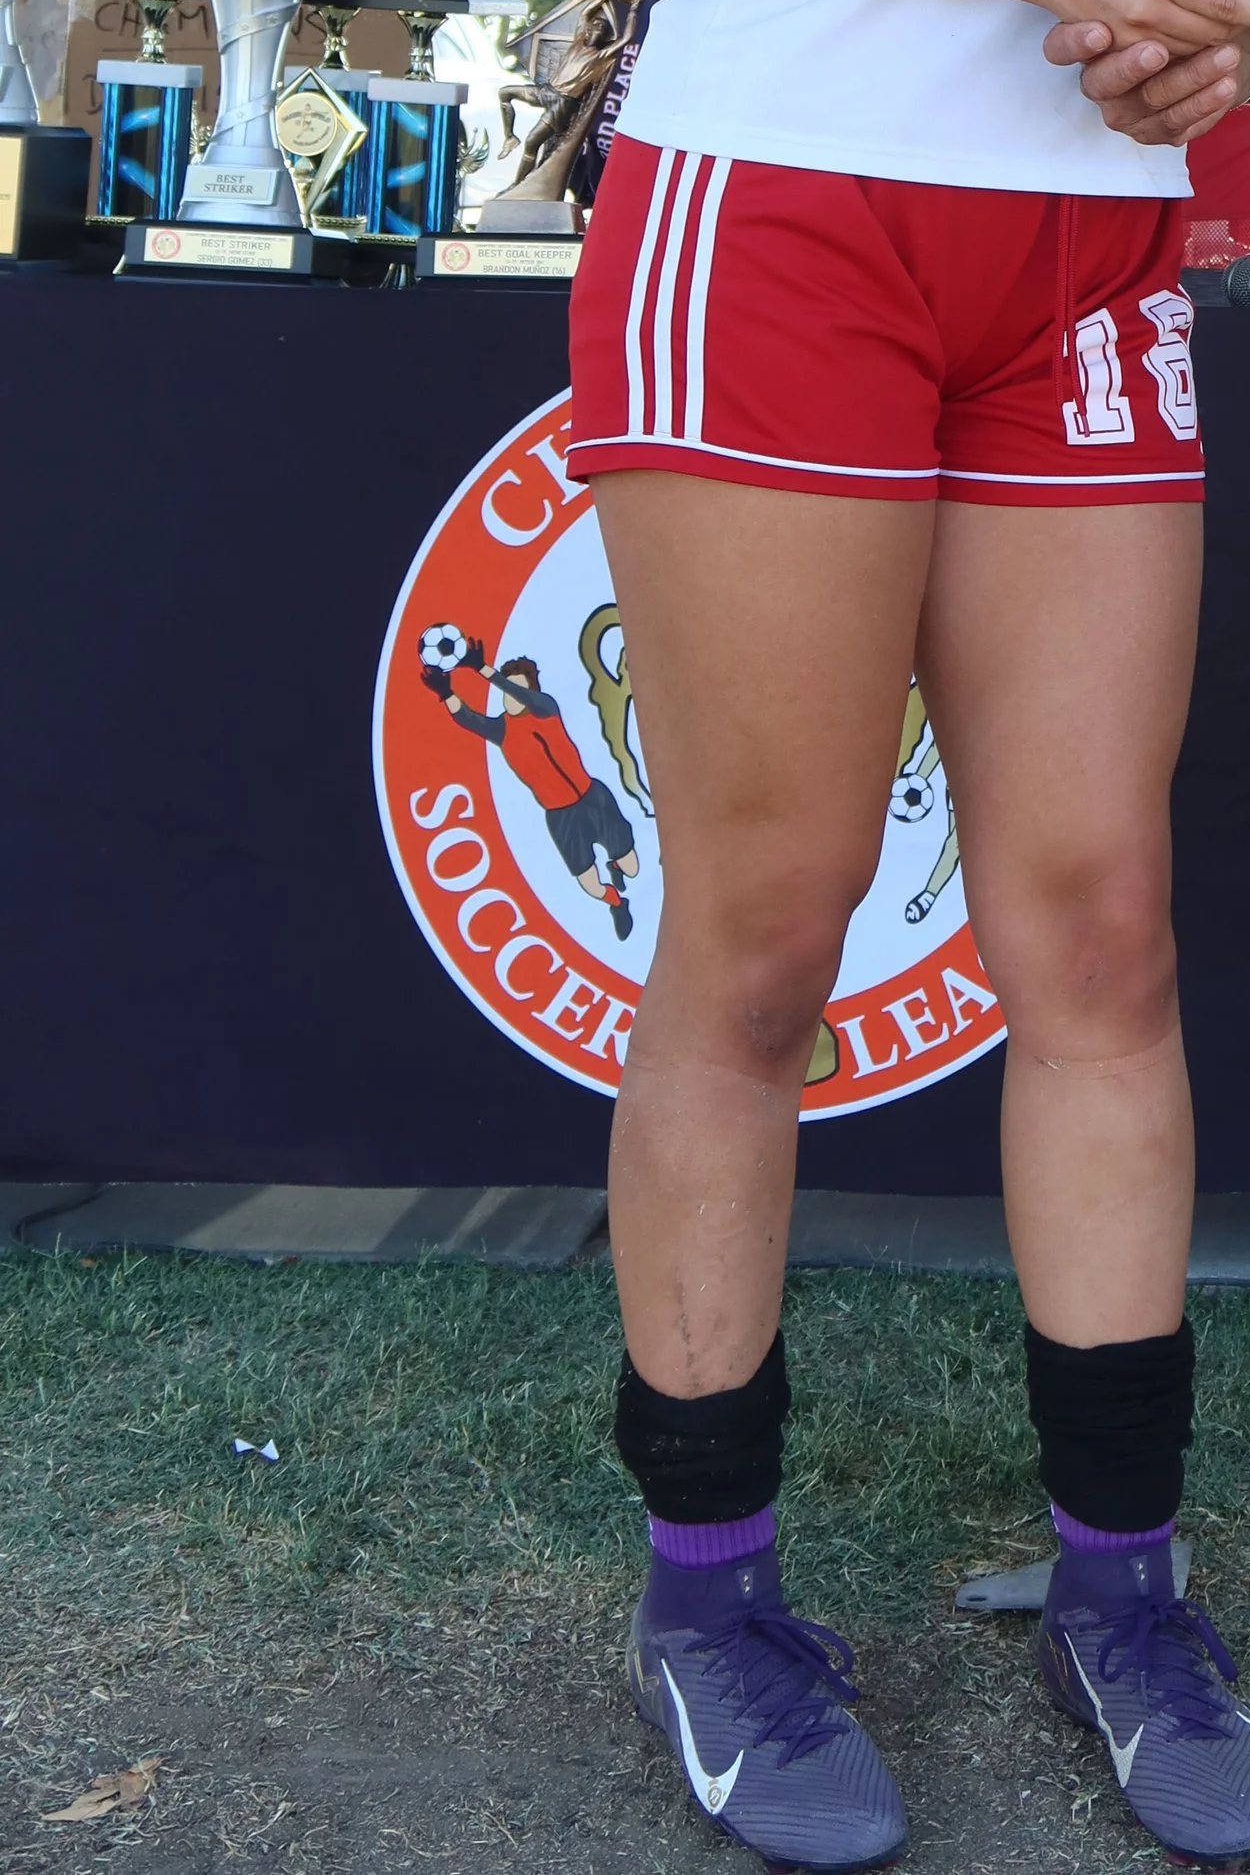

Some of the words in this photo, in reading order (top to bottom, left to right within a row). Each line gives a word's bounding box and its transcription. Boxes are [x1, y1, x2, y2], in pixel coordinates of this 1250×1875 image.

[603, 43, 640, 117] PLACE
[216, 174, 245, 184] BEST
[203, 183, 254, 194] STRIKER
[201, 239, 226, 248] BEST
[229, 240, 271, 250] STRIKER
[196, 254, 226, 264] SERGIO
[478, 248, 502, 258] BEST
[505, 249, 530, 258] GOAL
[534, 250, 572, 260] KEEPER
[483, 264, 521, 274] BRANDON
[1061, 288, 1198, 446] 16
